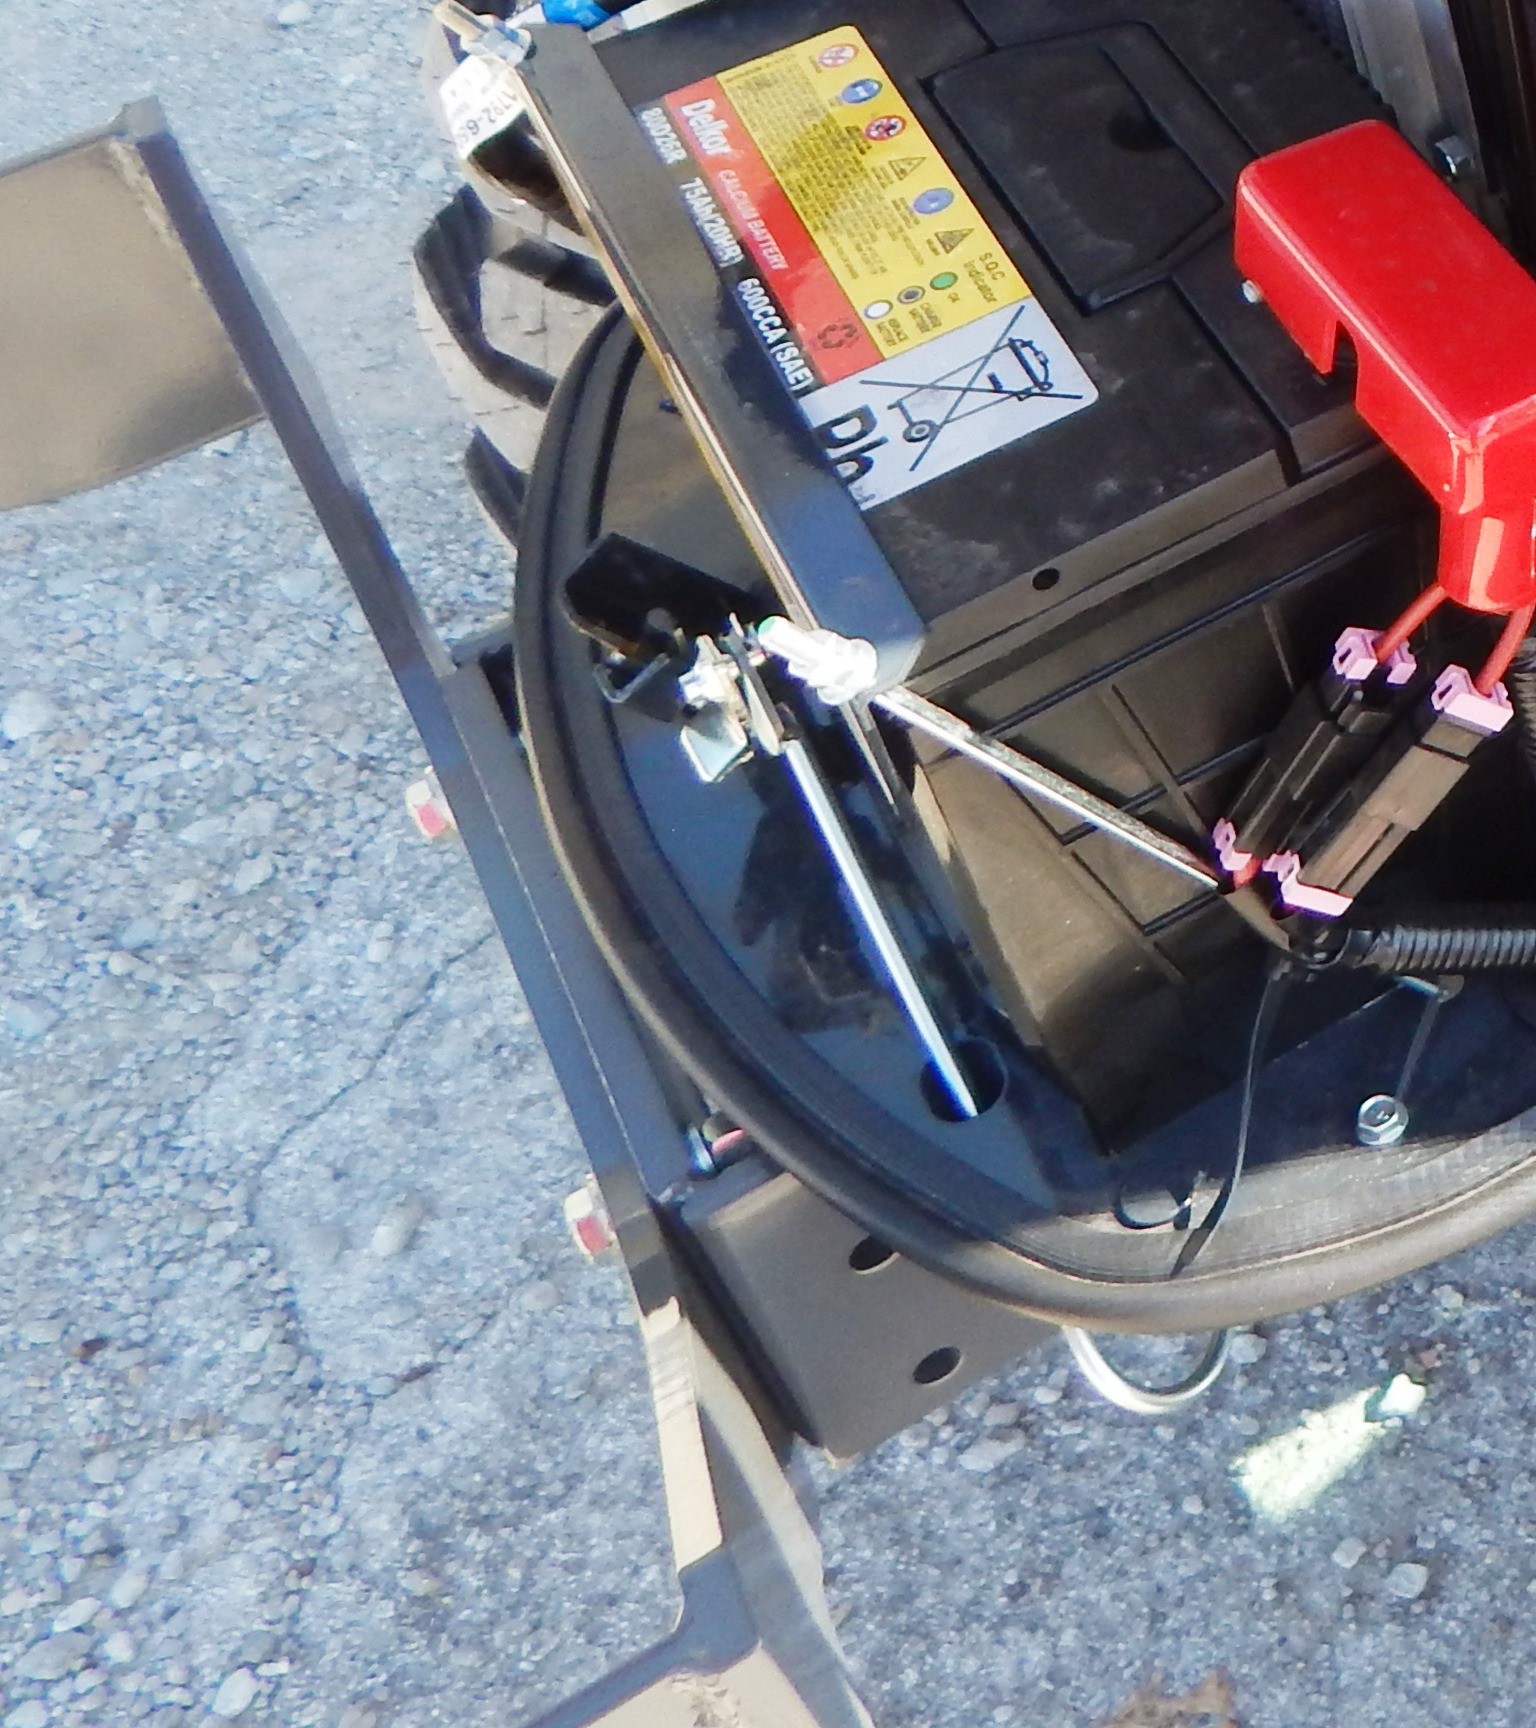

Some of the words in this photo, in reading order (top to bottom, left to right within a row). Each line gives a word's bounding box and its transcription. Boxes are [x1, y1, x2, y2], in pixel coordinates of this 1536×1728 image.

[680, 98, 732, 156] Delkor
[718, 169, 760, 220] CALCIUM
[748, 219, 789, 270] BATTERY
[737, 278, 787, 344] 600CCA
[770, 342, 814, 391] (SAE)
